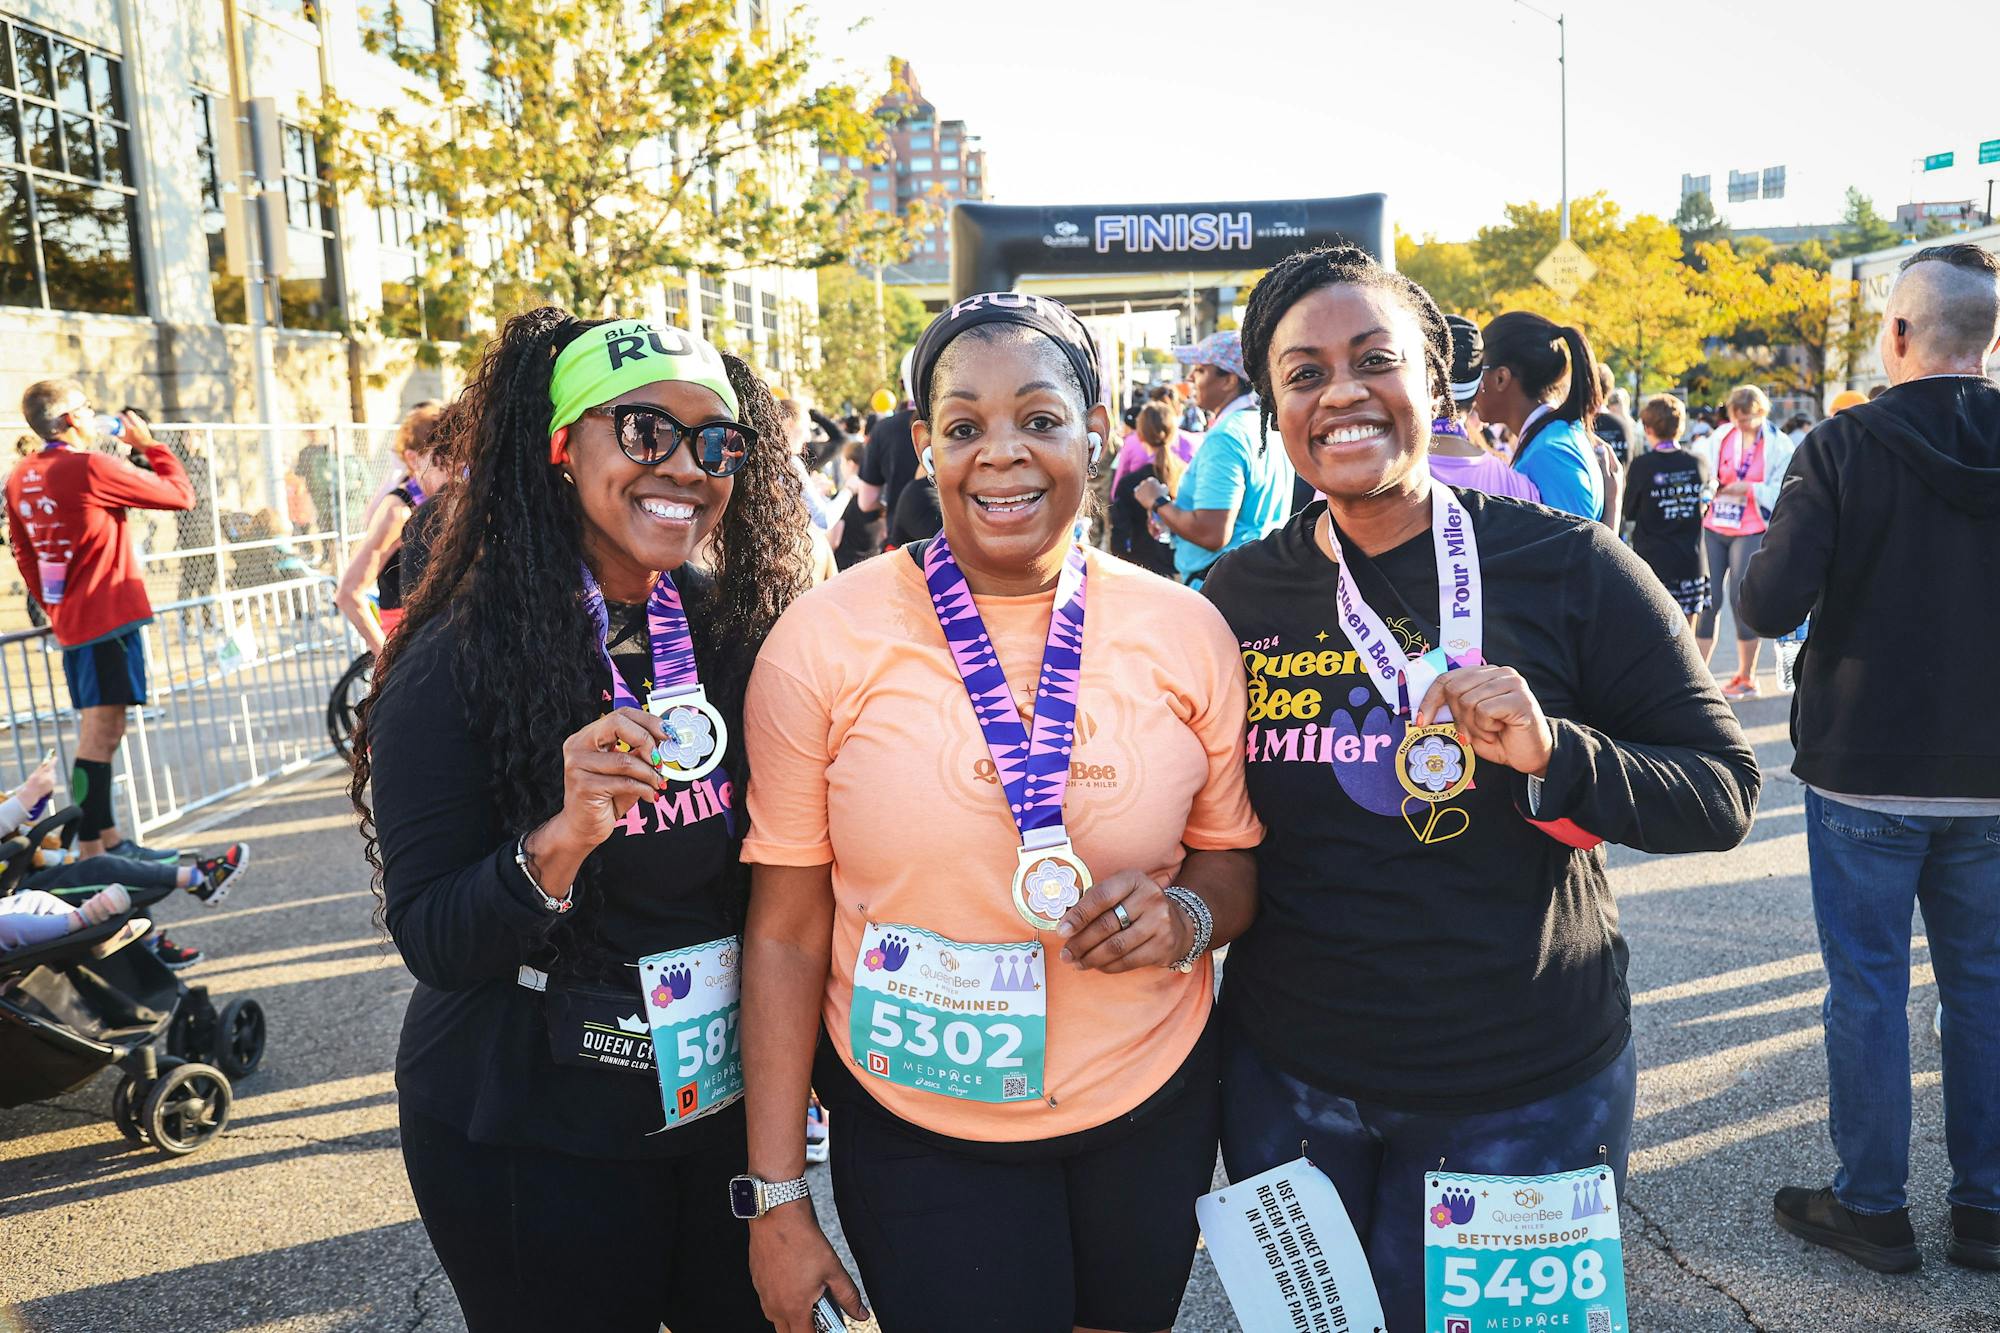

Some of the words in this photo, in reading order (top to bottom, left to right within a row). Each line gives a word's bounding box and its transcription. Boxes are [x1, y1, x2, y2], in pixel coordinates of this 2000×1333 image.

[1095, 212, 1252, 253] FINISH
[607, 331, 708, 371] RU
[1443, 502, 1466, 557] Miler
[1453, 563, 1471, 619] Four
[1337, 576, 1371, 642] Queen
[1367, 639, 1396, 680] Bee
[1241, 635, 1280, 651] 2024
[1247, 684, 1322, 723] Bee
[1070, 762, 1117, 780] Bee
[920, 964, 980, 988] QueenBee
[887, 980, 1009, 1011] DEE-TERMINED
[583, 1031, 634, 1056] QUEEN
[869, 1000, 1024, 1068] 5302
[599, 1055, 630, 1067] RUNNING
[631, 1060, 649, 1070] CLUB
[873, 1056, 885, 1071] D
[903, 1061, 982, 1085] MEDPACE
[682, 1089, 694, 1110] D
[1276, 1179, 1295, 1202] USE
[1285, 1201, 1305, 1223] THE
[1492, 1209, 1563, 1225] QueenBee
[1256, 1184, 1286, 1229] REDEEM
[1277, 1227, 1301, 1259] YOUR
[1291, 1256, 1322, 1311] FINISHER
[1296, 1222, 1323, 1259] TICKET
[1458, 1227, 1589, 1246] BETTYSMSBOOP
[1245, 1208, 1257, 1223] IN
[1252, 1220, 1271, 1244] THE
[1262, 1242, 1285, 1270] POST
[1274, 1269, 1298, 1300] RACE
[1313, 1259, 1330, 1278] ON
[1441, 1249, 1607, 1308] 5498
[1320, 1276, 1340, 1304] THIS
[1330, 1305, 1347, 1327] BIB
[1486, 1312, 1569, 1329] MEDPACE
